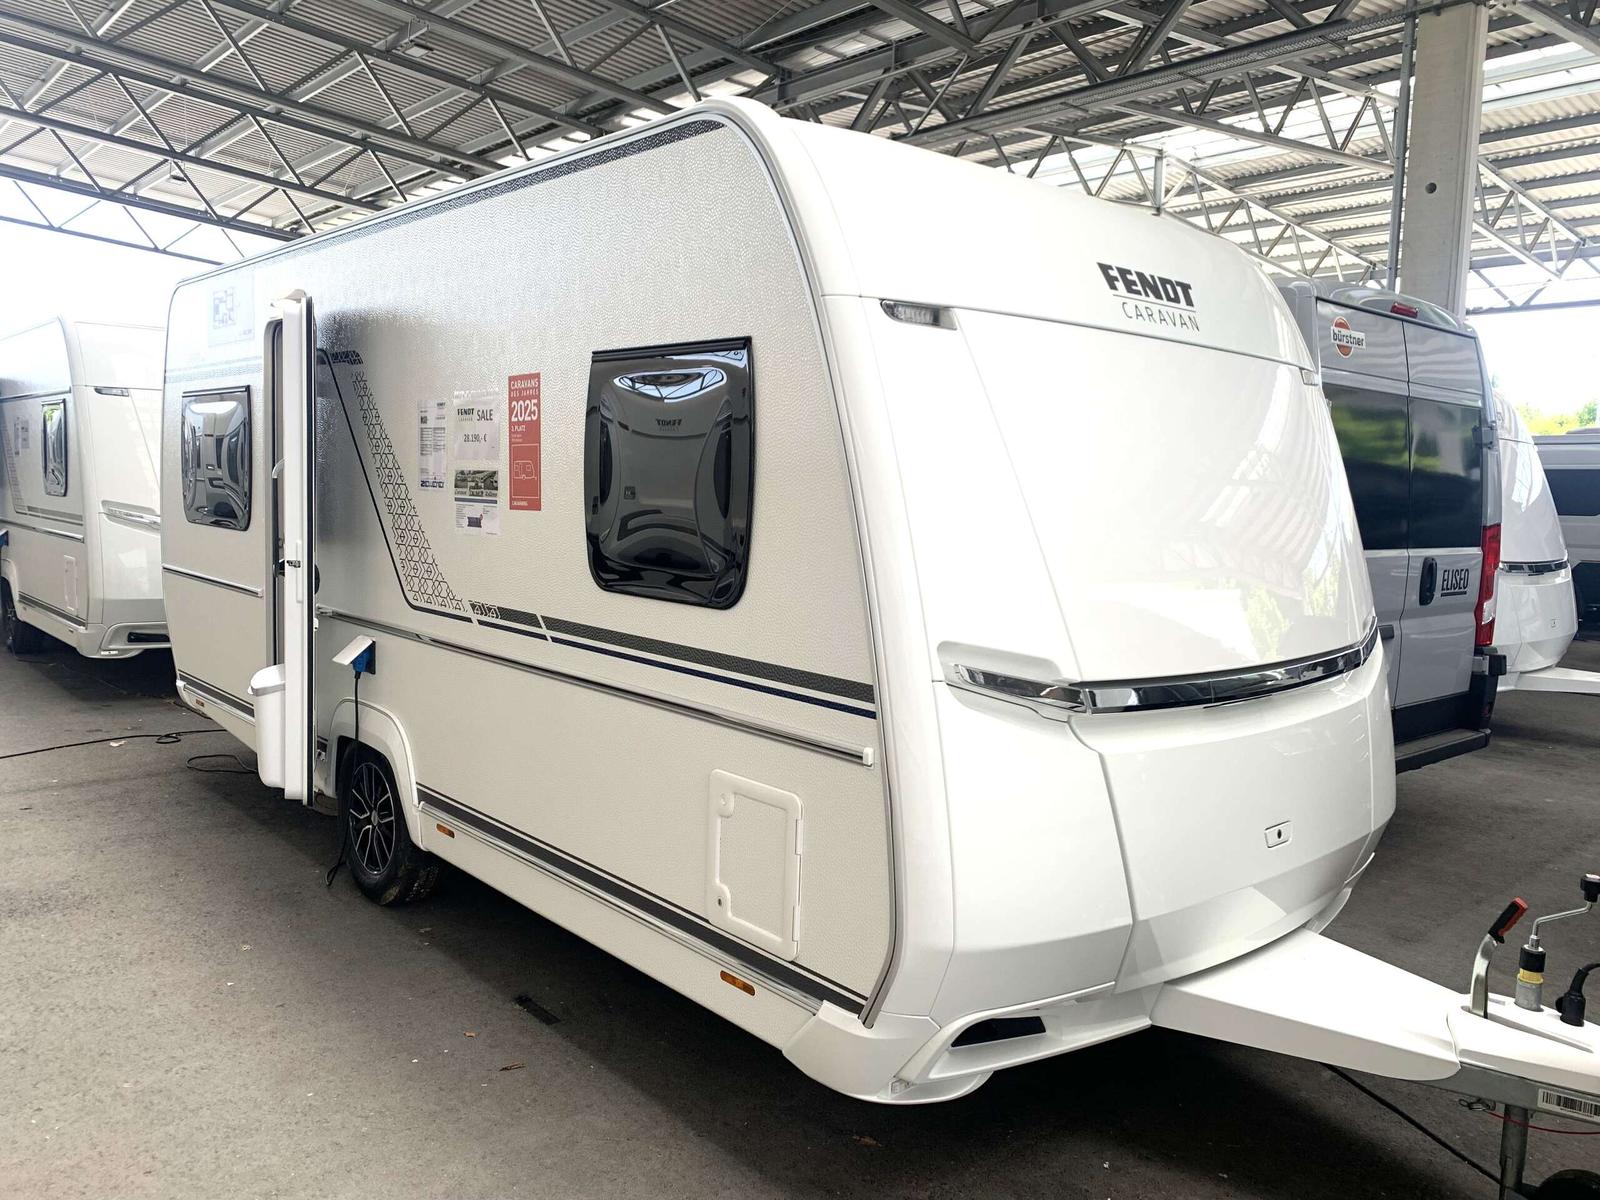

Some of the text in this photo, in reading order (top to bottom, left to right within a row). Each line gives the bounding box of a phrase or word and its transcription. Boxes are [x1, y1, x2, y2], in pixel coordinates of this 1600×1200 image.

[1096, 262, 1194, 307] FENDT
[1121, 301, 1200, 332] CARAVAN
[1332, 329, 1364, 347] bürstner
[510, 378, 539, 390] CARAVANS
[457, 408, 475, 416] FENDT
[476, 409, 494, 422] SALE
[511, 398, 538, 422] 2025
[483, 433, 488, 443] €
[1441, 568, 1470, 592] ELISEO
